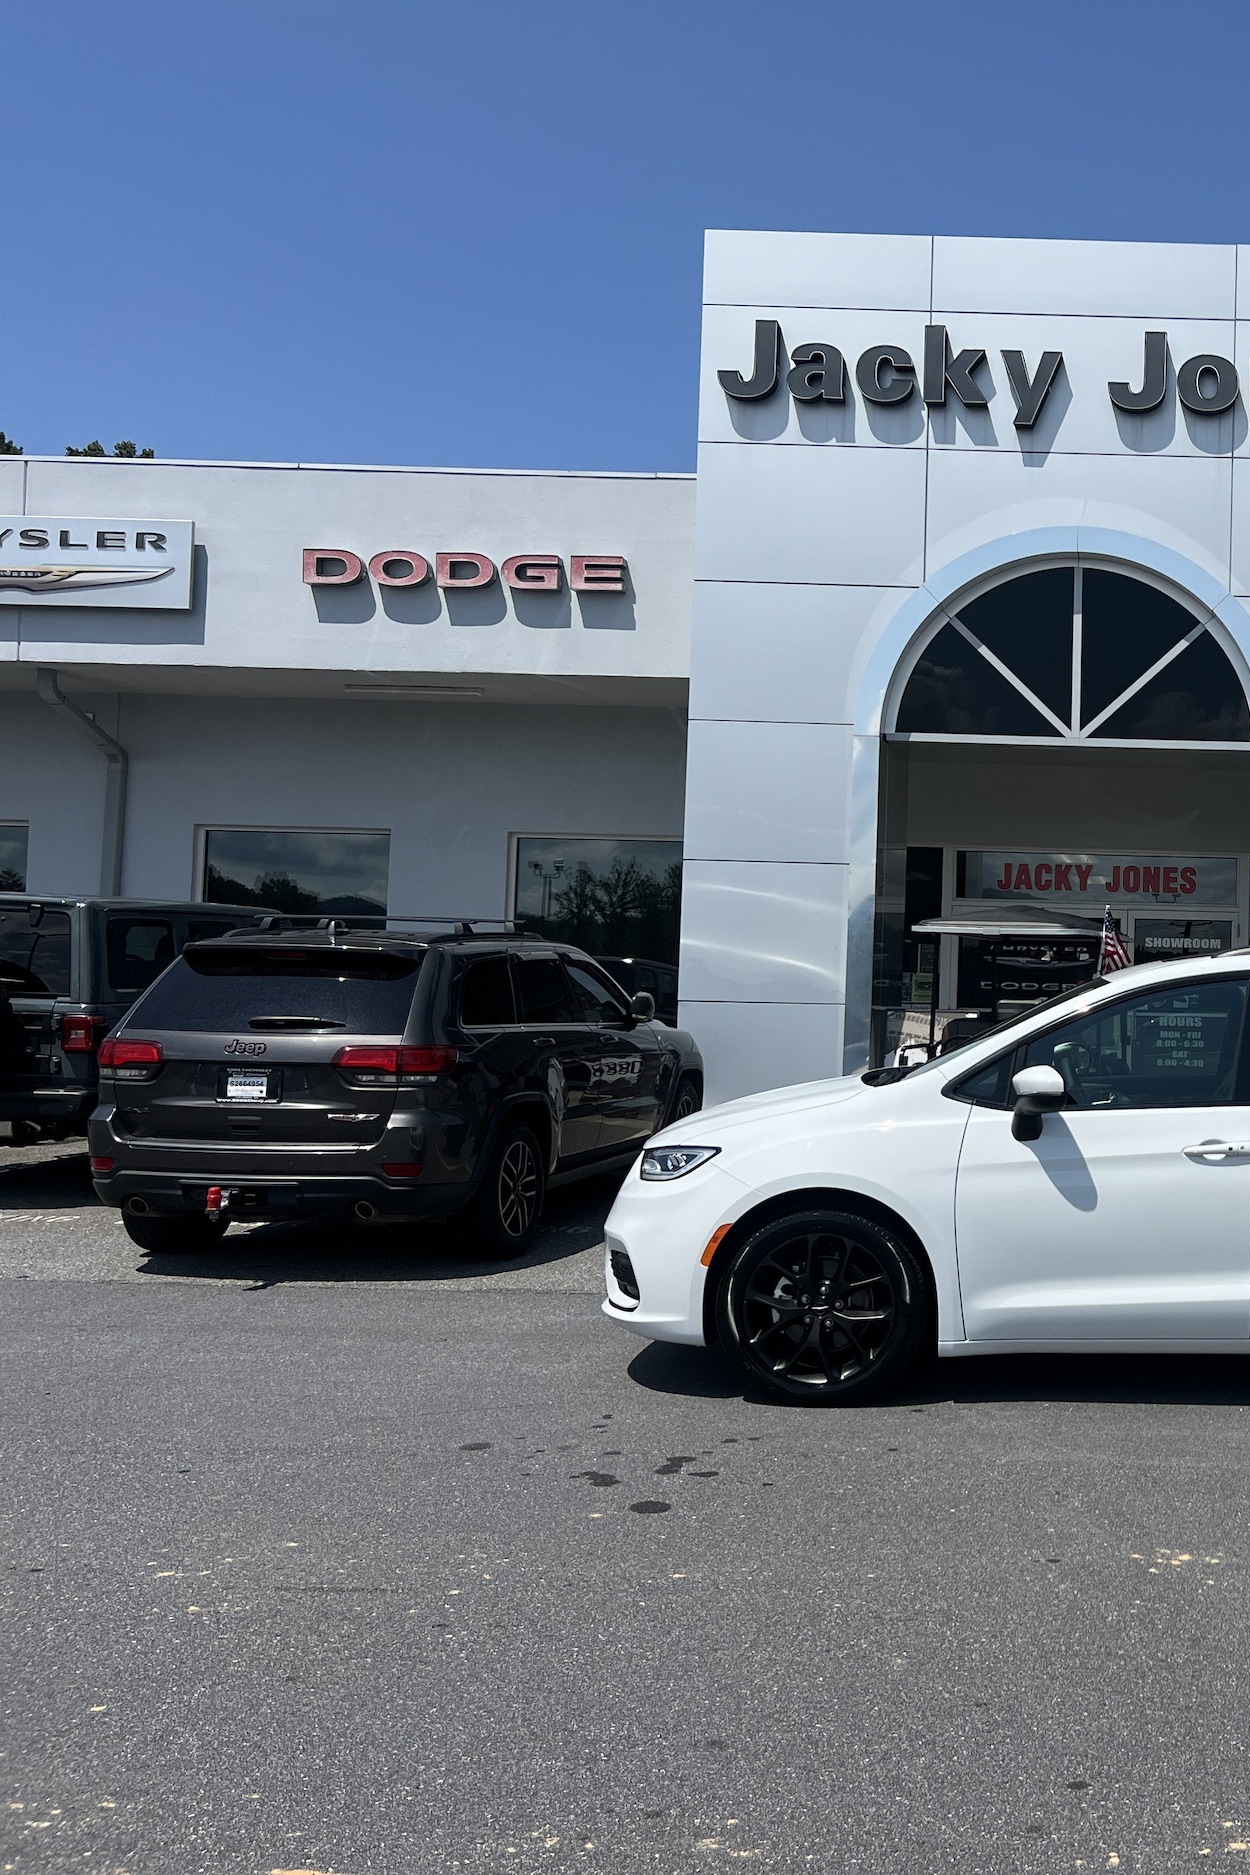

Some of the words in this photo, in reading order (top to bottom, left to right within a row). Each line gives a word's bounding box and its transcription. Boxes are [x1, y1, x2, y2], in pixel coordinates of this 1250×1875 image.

[717, 319, 1063, 429] Jacky
[302, 547, 627, 594] DODGE
[996, 862, 1094, 892] JACKY
[1104, 865, 1198, 895] JONES
[1144, 936, 1221, 949] SHOWROOM
[1159, 1016, 1203, 1027] HOURS
[1187, 1031, 1202, 1039] FRI
[224, 1039, 268, 1057] Jeep
[1156, 1039, 1177, 1047] 8:00
[1184, 1040, 1204, 1048] 6:30
[1172, 1050, 1189, 1058] SAT
[1156, 1059, 1177, 1067] 8:00
[1184, 1059, 1204, 1067] 4:30
